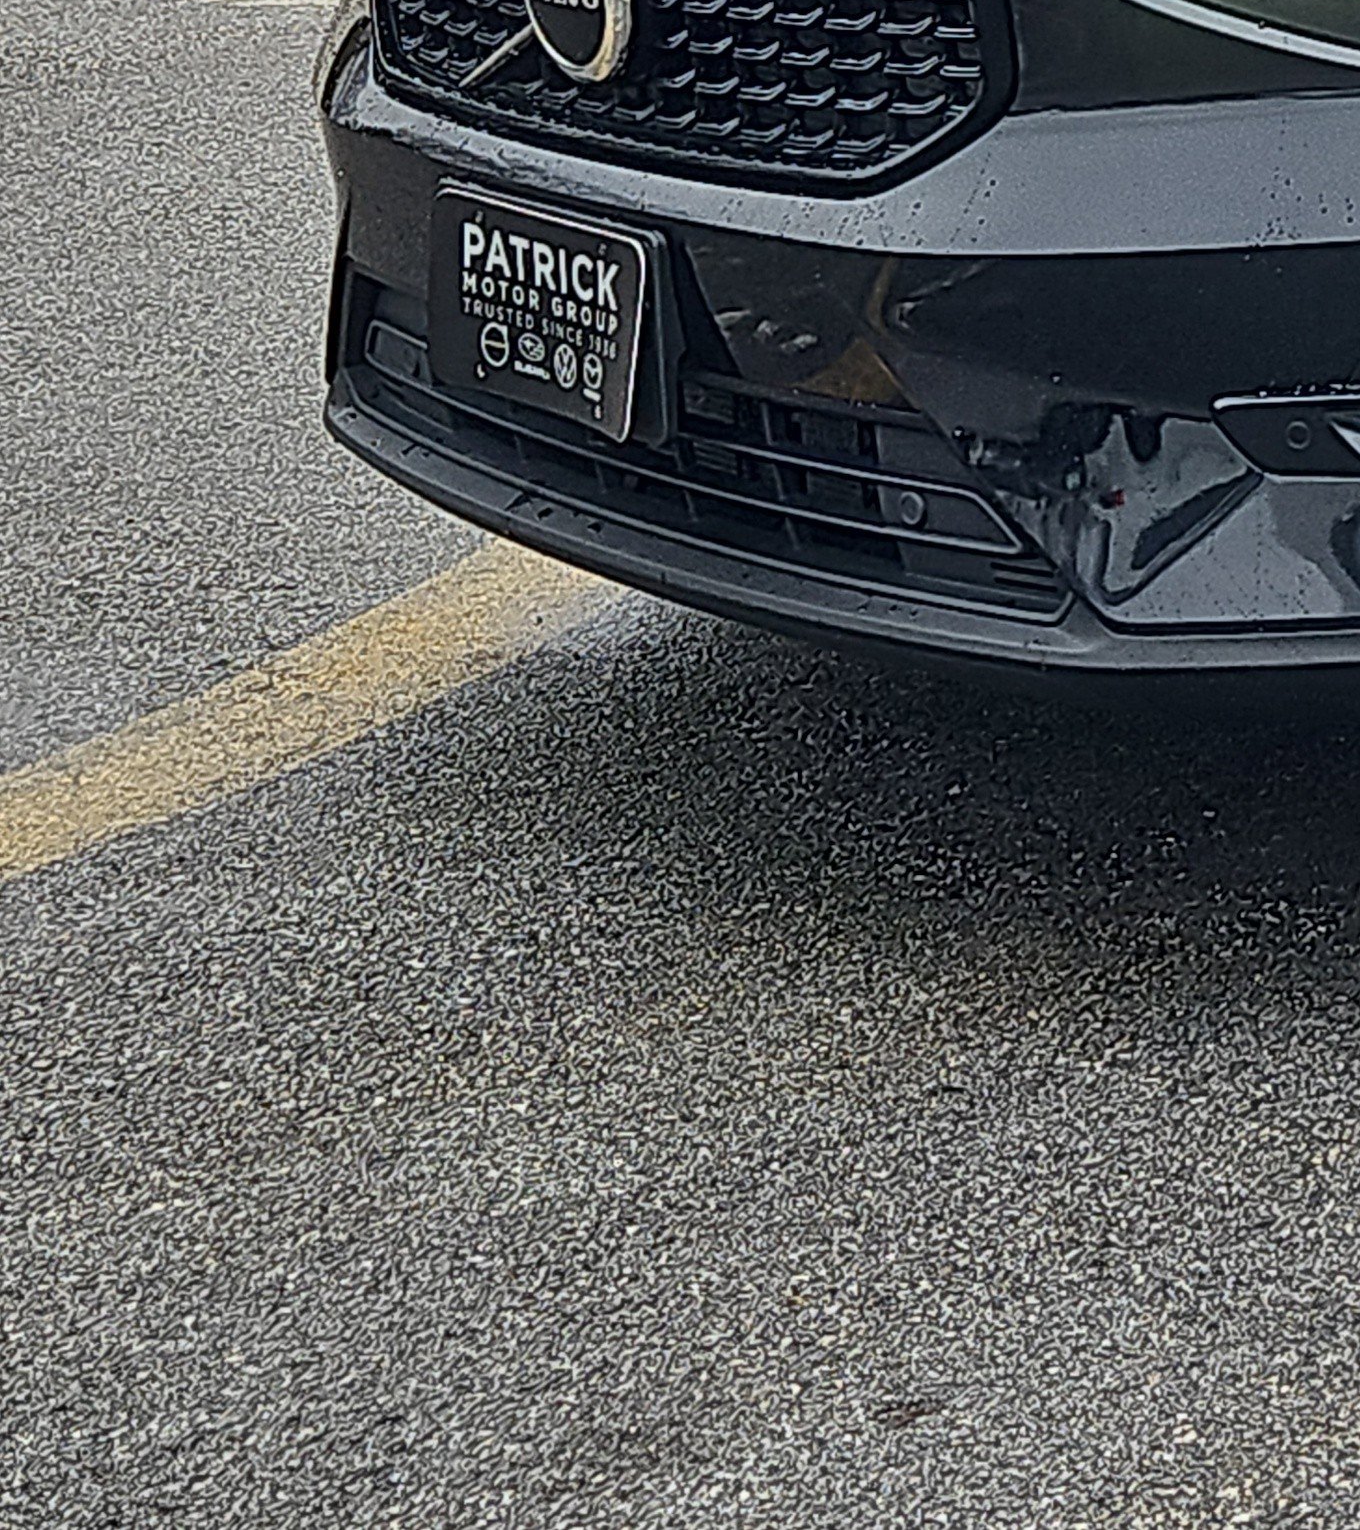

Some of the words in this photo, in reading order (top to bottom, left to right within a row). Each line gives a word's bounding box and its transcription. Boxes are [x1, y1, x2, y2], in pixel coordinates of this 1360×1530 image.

[462, 221, 620, 312] PATRICK
[461, 270, 540, 311] MOTOR
[551, 296, 618, 336] GROUP
[462, 296, 535, 330] TRUSTED
[541, 318, 583, 347] SINCE
